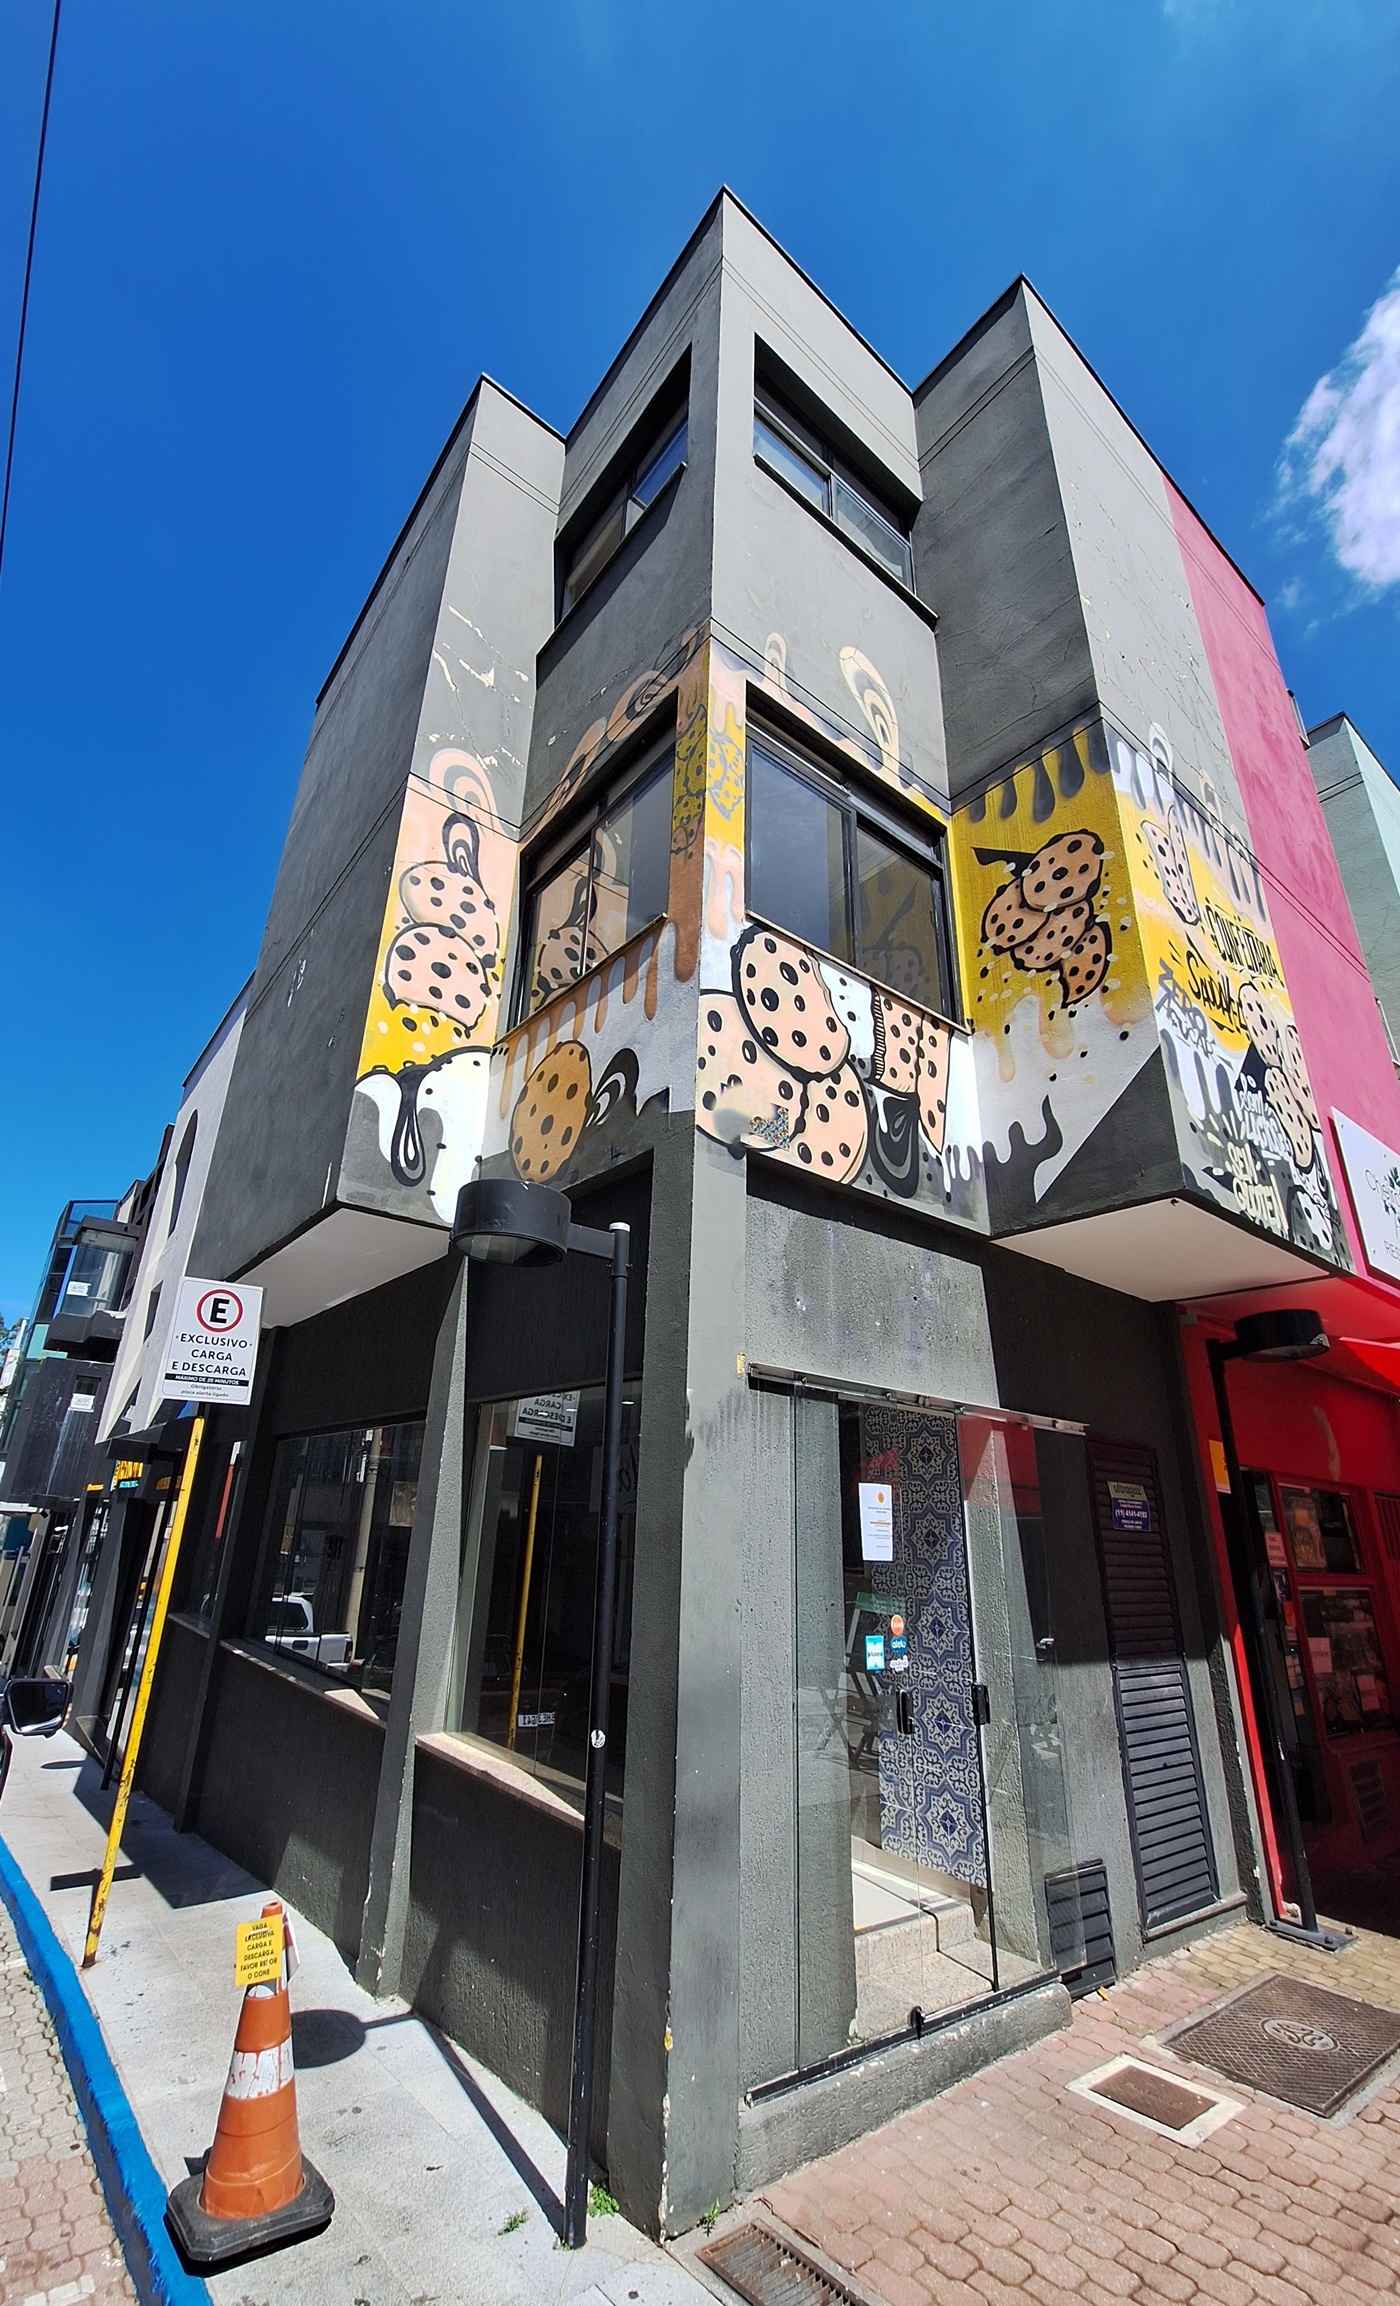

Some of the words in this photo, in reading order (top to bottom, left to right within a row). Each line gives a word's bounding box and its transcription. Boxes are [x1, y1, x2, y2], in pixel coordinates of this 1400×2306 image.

[209, 1297, 230, 1324] E
[180, 1333, 248, 1349] EXCLUSIVO
[191, 1349, 233, 1361] CARGA
[172, 1361, 178, 1370] E
[182, 1361, 246, 1376] DESCARGA
